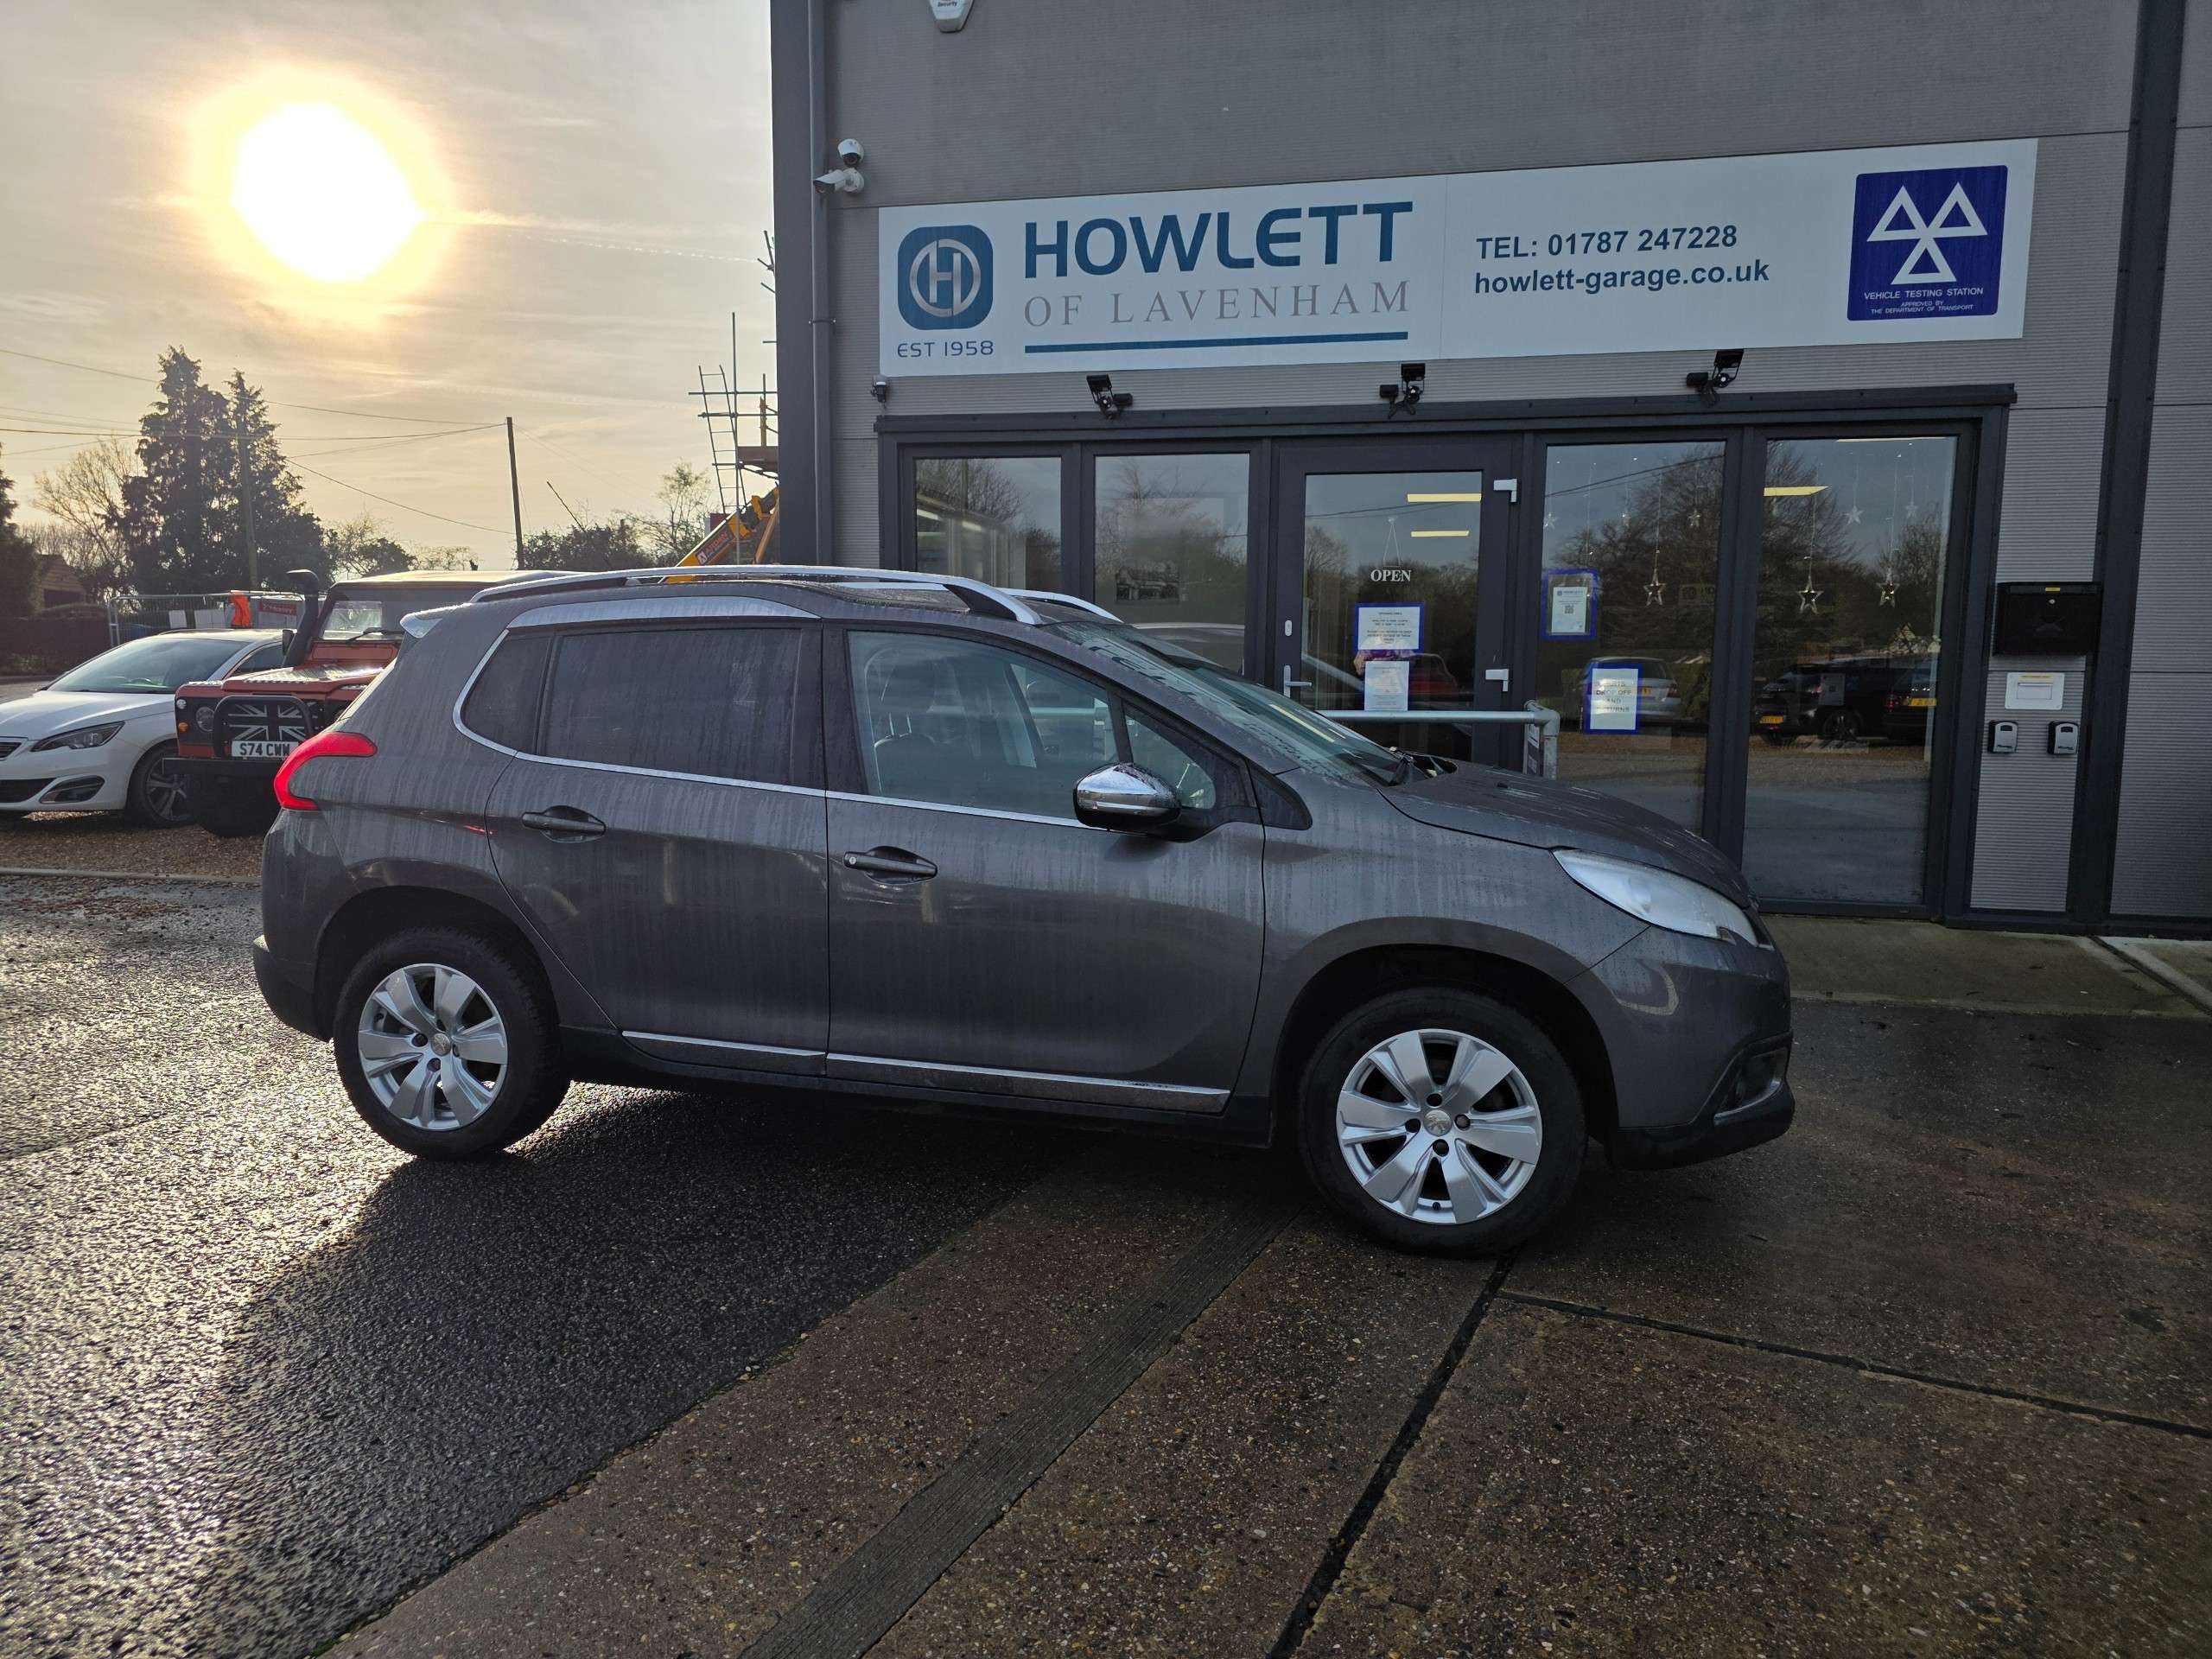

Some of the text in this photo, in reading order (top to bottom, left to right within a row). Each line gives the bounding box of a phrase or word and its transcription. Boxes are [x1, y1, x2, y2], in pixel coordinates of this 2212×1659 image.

[1025, 201, 1413, 278] HOWLETT
[1476, 225, 1737, 259] TEL: 01787 247228
[1475, 260, 1770, 295] howlett-garage.co.uk
[1025, 280, 1410, 327] OF LAVENHAM
[1864, 287, 1984, 300] VEHICLE TESTING STATION
[897, 340, 994, 358] EST 1958
[1370, 569, 1412, 582] OPEN
[239, 742, 263, 756] S74
